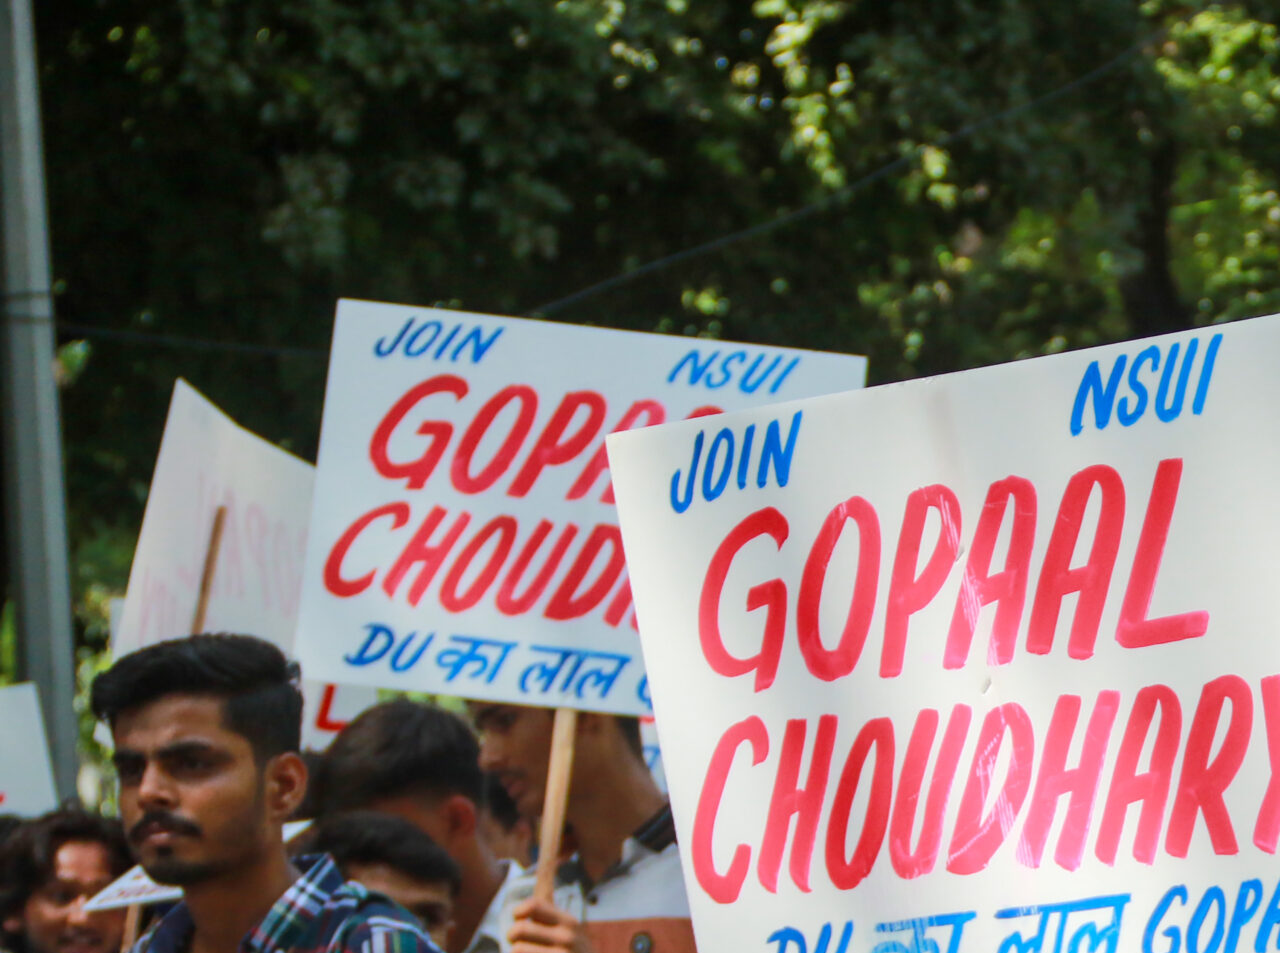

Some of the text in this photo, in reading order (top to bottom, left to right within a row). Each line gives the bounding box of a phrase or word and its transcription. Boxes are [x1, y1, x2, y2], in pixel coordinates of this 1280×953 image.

[373, 318, 802, 393] JOIN NSUI
[369, 374, 724, 504] GOPA
[670, 333, 1224, 514] JOIN NSUI
[322, 501, 639, 632] CHOUD
[698, 458, 1210, 693] GOPAAL
[344, 623, 434, 674] DU
[435, 635, 518, 685] का
[518, 644, 632, 699] लाल
